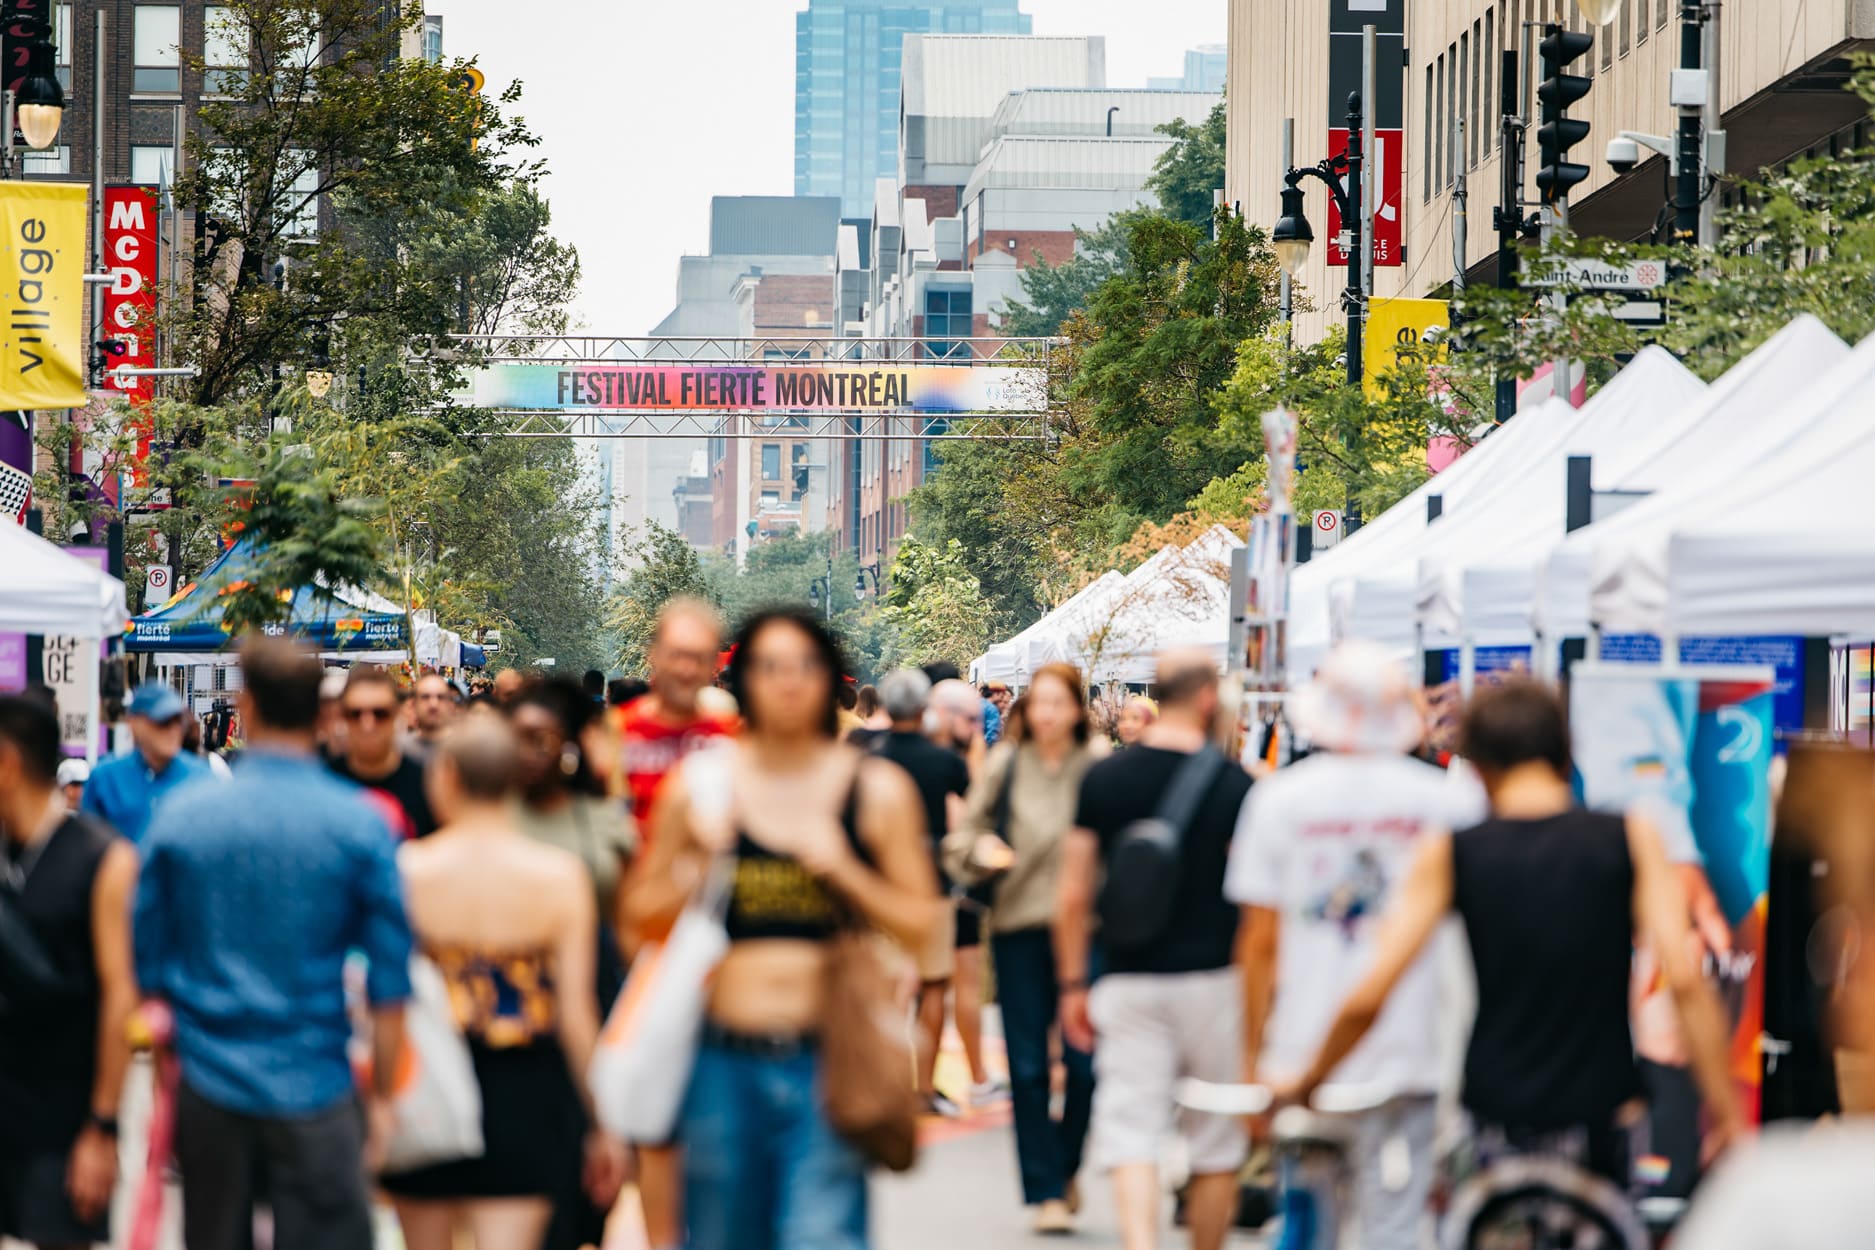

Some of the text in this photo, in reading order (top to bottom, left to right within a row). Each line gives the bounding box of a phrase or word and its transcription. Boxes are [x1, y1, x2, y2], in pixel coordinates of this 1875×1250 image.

[11, 218, 54, 374] village
[557, 370, 914, 407] FESTIVAL FIERTÉ MONTRÉAL
